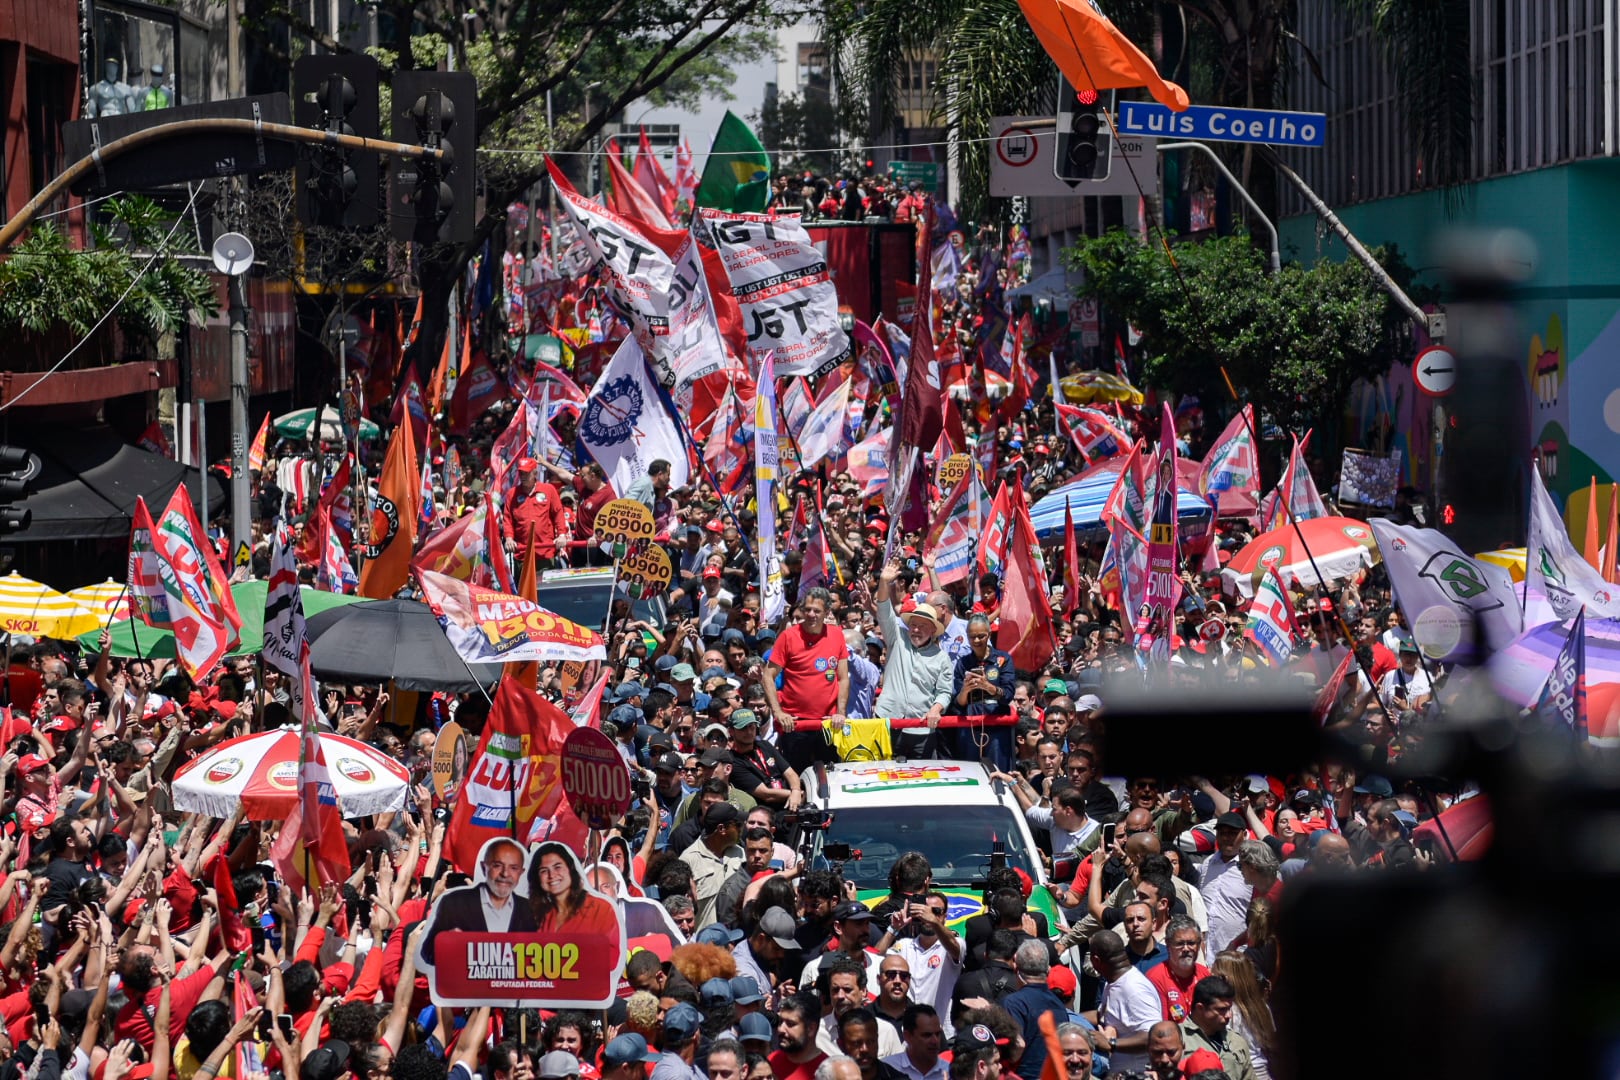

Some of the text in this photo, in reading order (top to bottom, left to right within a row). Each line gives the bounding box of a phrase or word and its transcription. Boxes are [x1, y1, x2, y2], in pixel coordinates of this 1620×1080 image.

[1126, 108, 1316, 141] Luís Coelho
[744, 282, 762, 293] UGT
[763, 275, 782, 288] UGT
[783, 270, 802, 282] UGT
[804, 263, 822, 275] UGT
[597, 514, 653, 535] 50900
[609, 508, 642, 520] pretas
[5, 619, 39, 632] SKOL
[480, 612, 593, 646] 13011
[497, 631, 545, 652] DEPUTADO
[547, 631, 561, 639] DA
[563, 663, 579, 680] 5000
[433, 762, 451, 773] 5000
[563, 757, 627, 801] 50000
[467, 941, 580, 980] LUNA 1302
[467, 965, 515, 980] ZARATTINI
[491, 981, 555, 989] DEPUTADA FEDERAL
